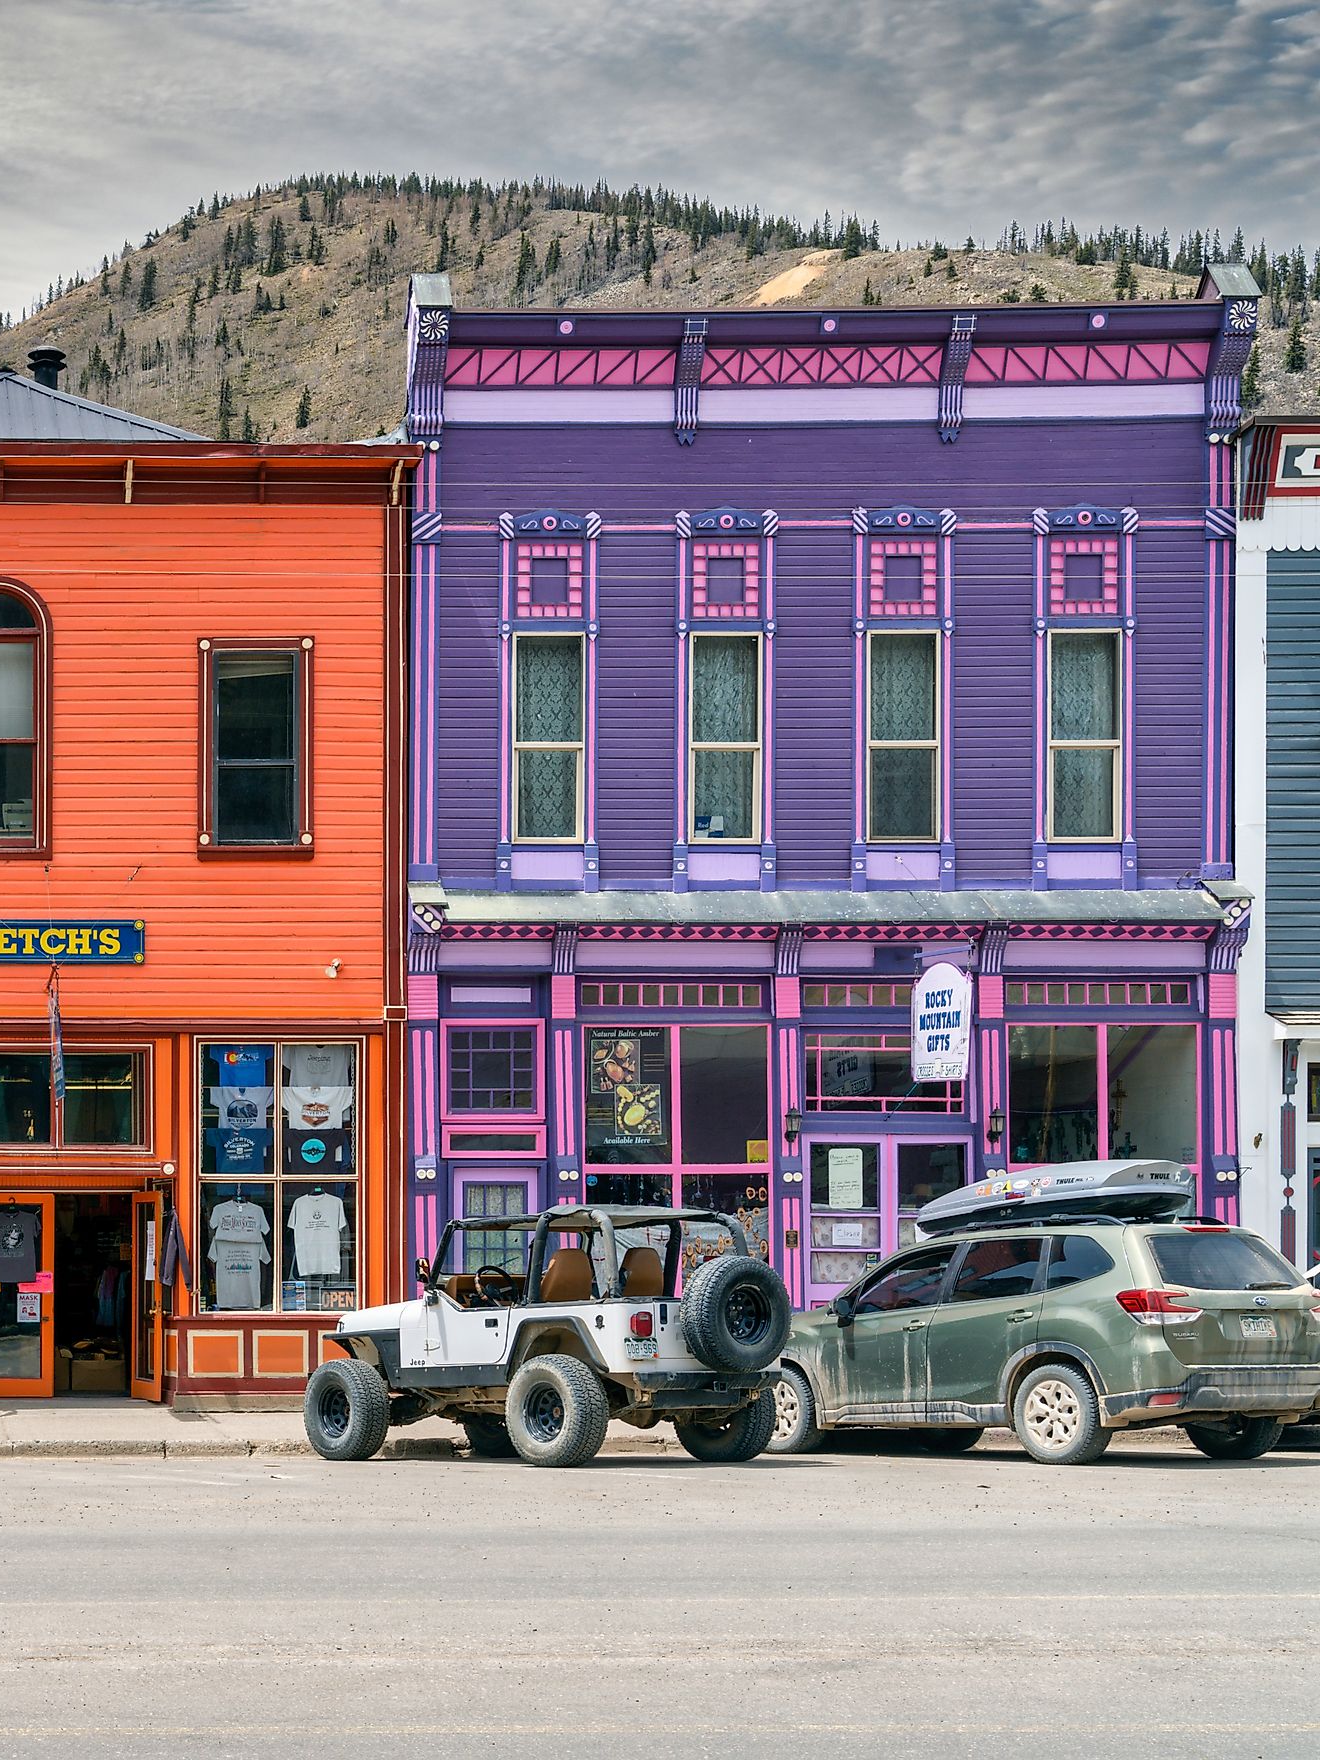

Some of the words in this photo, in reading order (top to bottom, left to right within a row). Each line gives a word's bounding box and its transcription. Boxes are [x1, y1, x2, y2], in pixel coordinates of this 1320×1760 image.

[925, 988, 953, 1010] ROCKY
[919, 1010, 961, 1031] MOUNTAIN
[592, 1030, 617, 1038] Natural
[618, 1029, 637, 1037] Baltic
[638, 1029, 660, 1037] Amber
[926, 1033, 950, 1053] GIFTS
[223, 1136, 256, 1149] SILVERTON
[603, 1137, 633, 1145] Available
[1055, 1177, 1075, 1185] THULE
[322, 1291, 354, 1308] OPEN
[409, 1358, 426, 1367] Jeep
